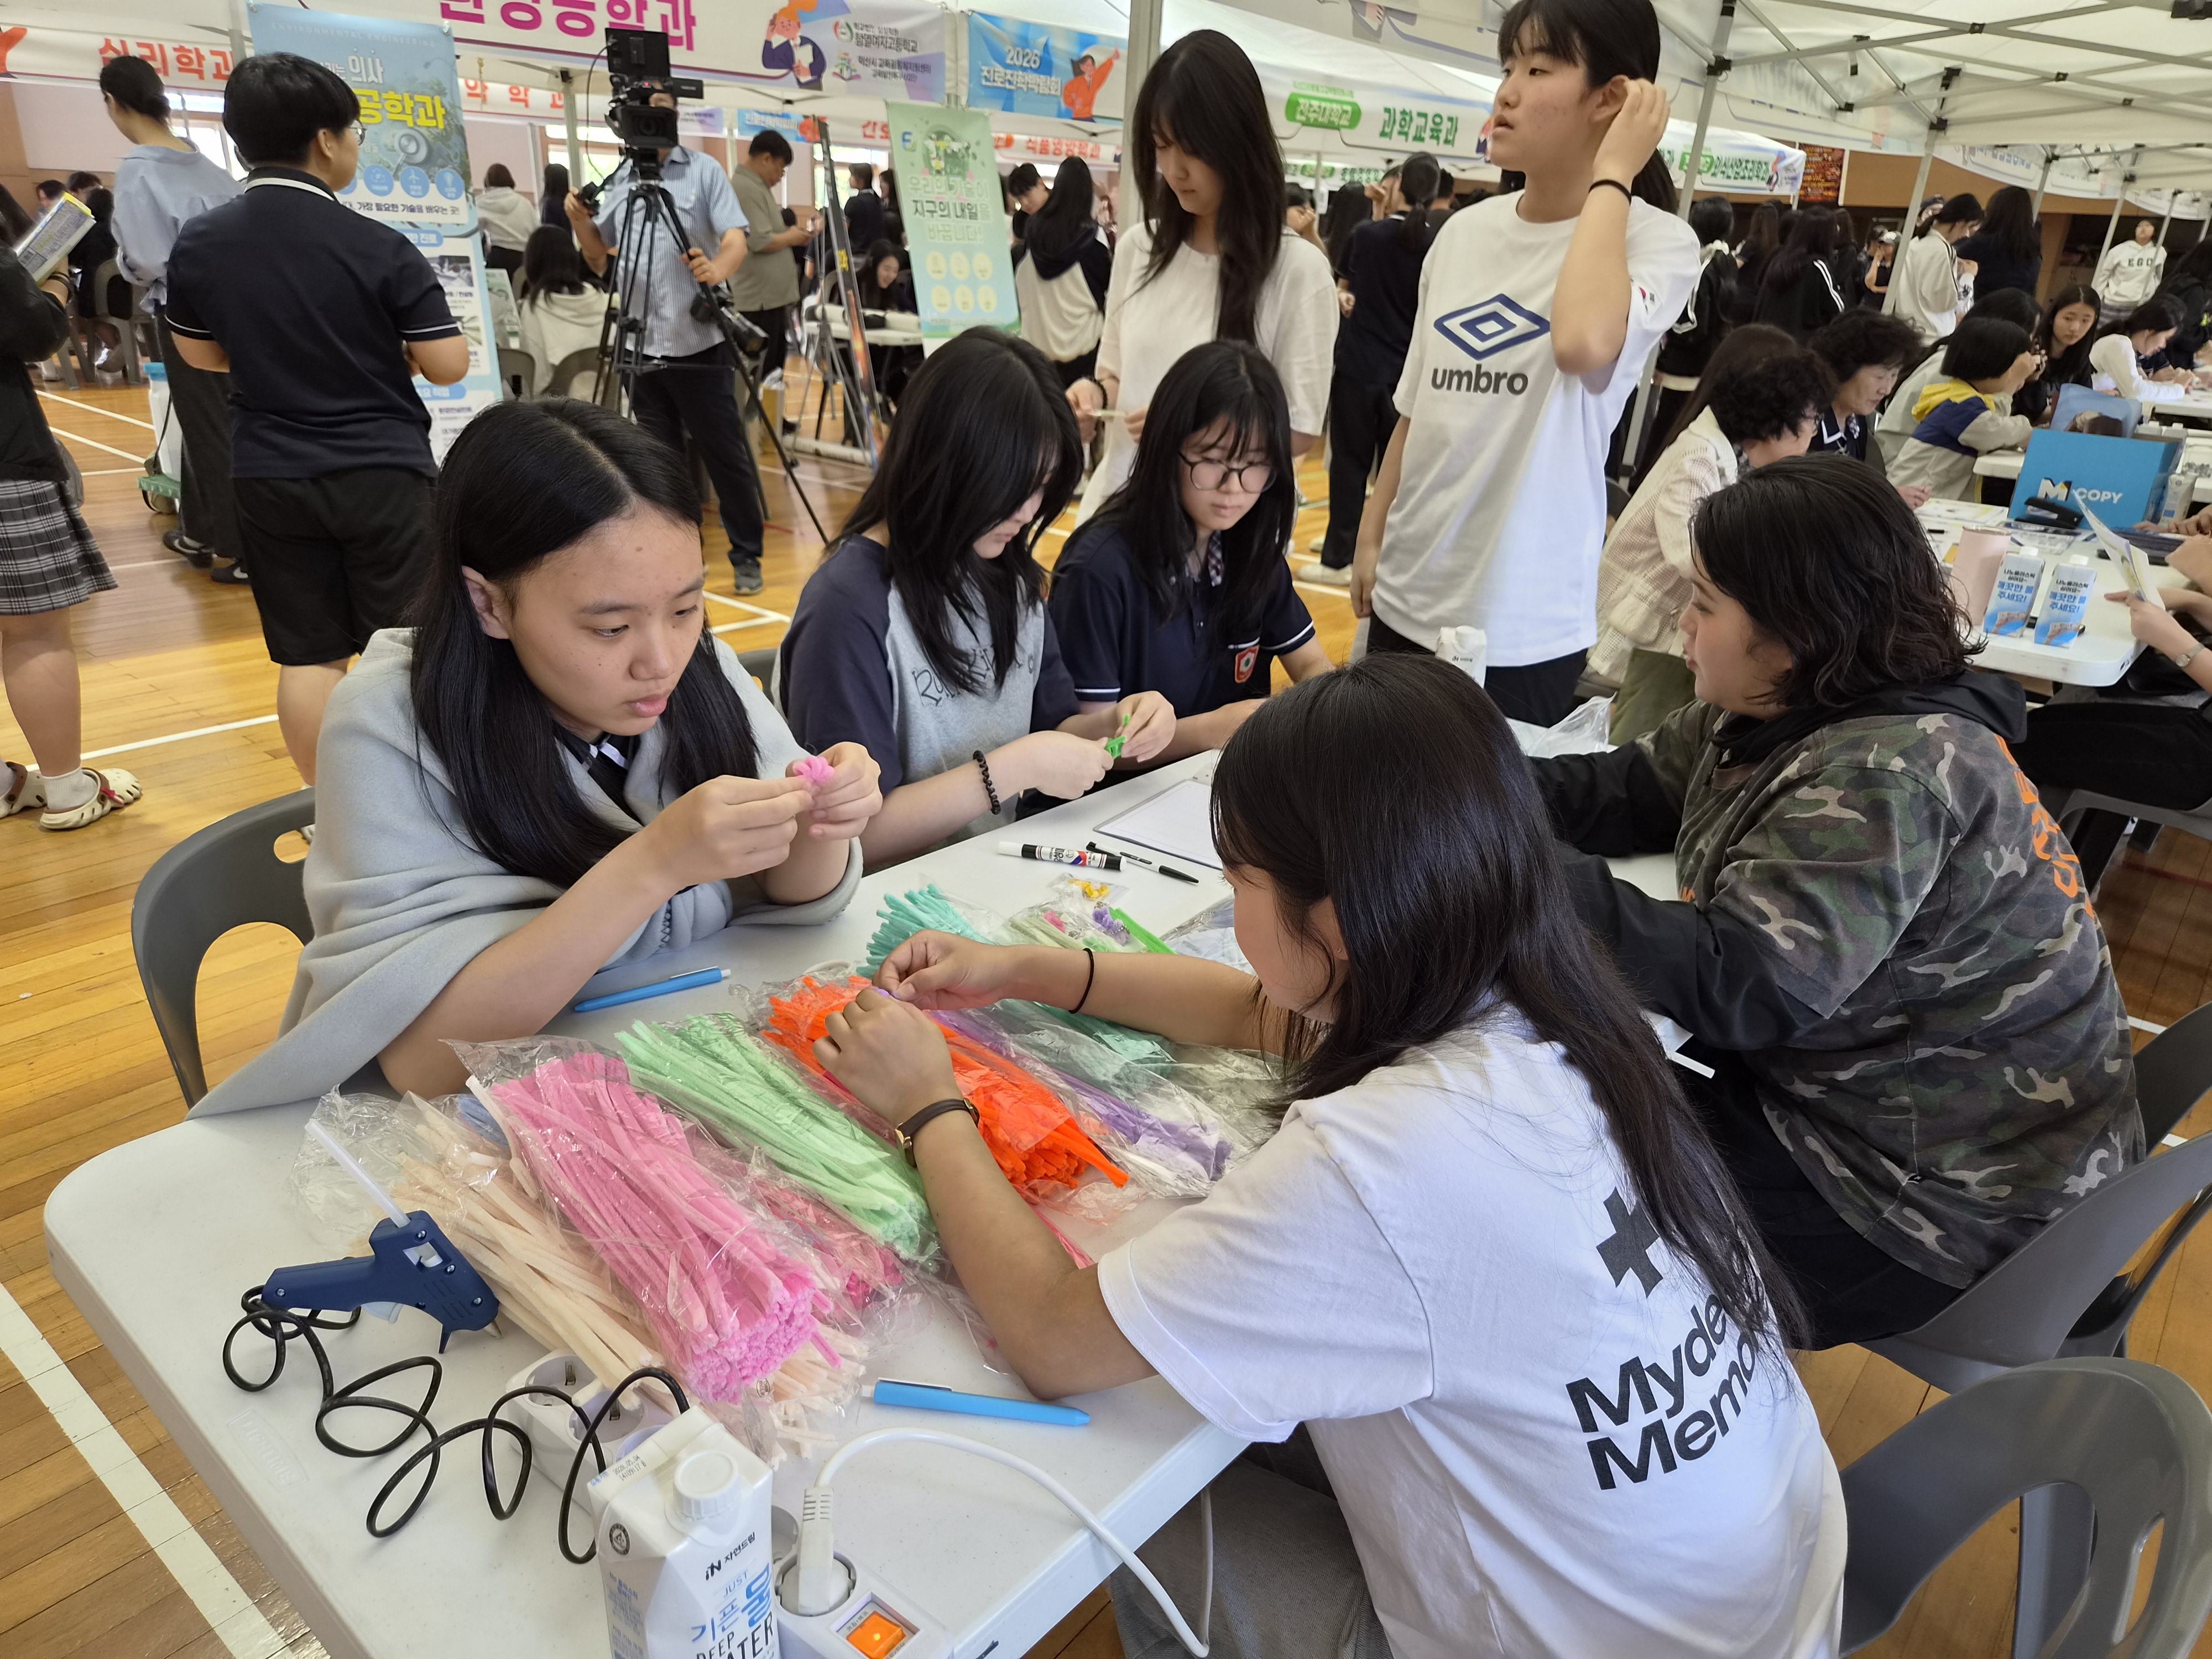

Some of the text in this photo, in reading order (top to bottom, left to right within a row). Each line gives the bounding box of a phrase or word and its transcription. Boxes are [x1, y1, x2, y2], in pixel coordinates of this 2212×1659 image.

[348, 54, 384, 84] 의사
[1006, 46, 1041, 70] 2026
[982, 66, 1061, 96] 진로진학박람회
[1379, 107, 1458, 147] 과학교육과
[909, 176, 947, 195] 우리의
[912, 199, 990, 221] 지구의 내일을
[928, 223, 983, 242] 바꿉니다!
[1431, 363, 1528, 396] umbro
[2075, 487, 2124, 504] COPY
[1997, 581, 2024, 593] 깨끗한
[1997, 591, 2027, 603] 주세요!
[2049, 591, 2077, 603] 깨끗한
[2049, 601, 2080, 614] 주세요!
[1566, 1294, 1726, 1433] Myde
[1586, 1330, 1760, 1490] Memo
[724, 1531, 755, 1564] 자연드림
[723, 1569, 748, 1598] JUST
